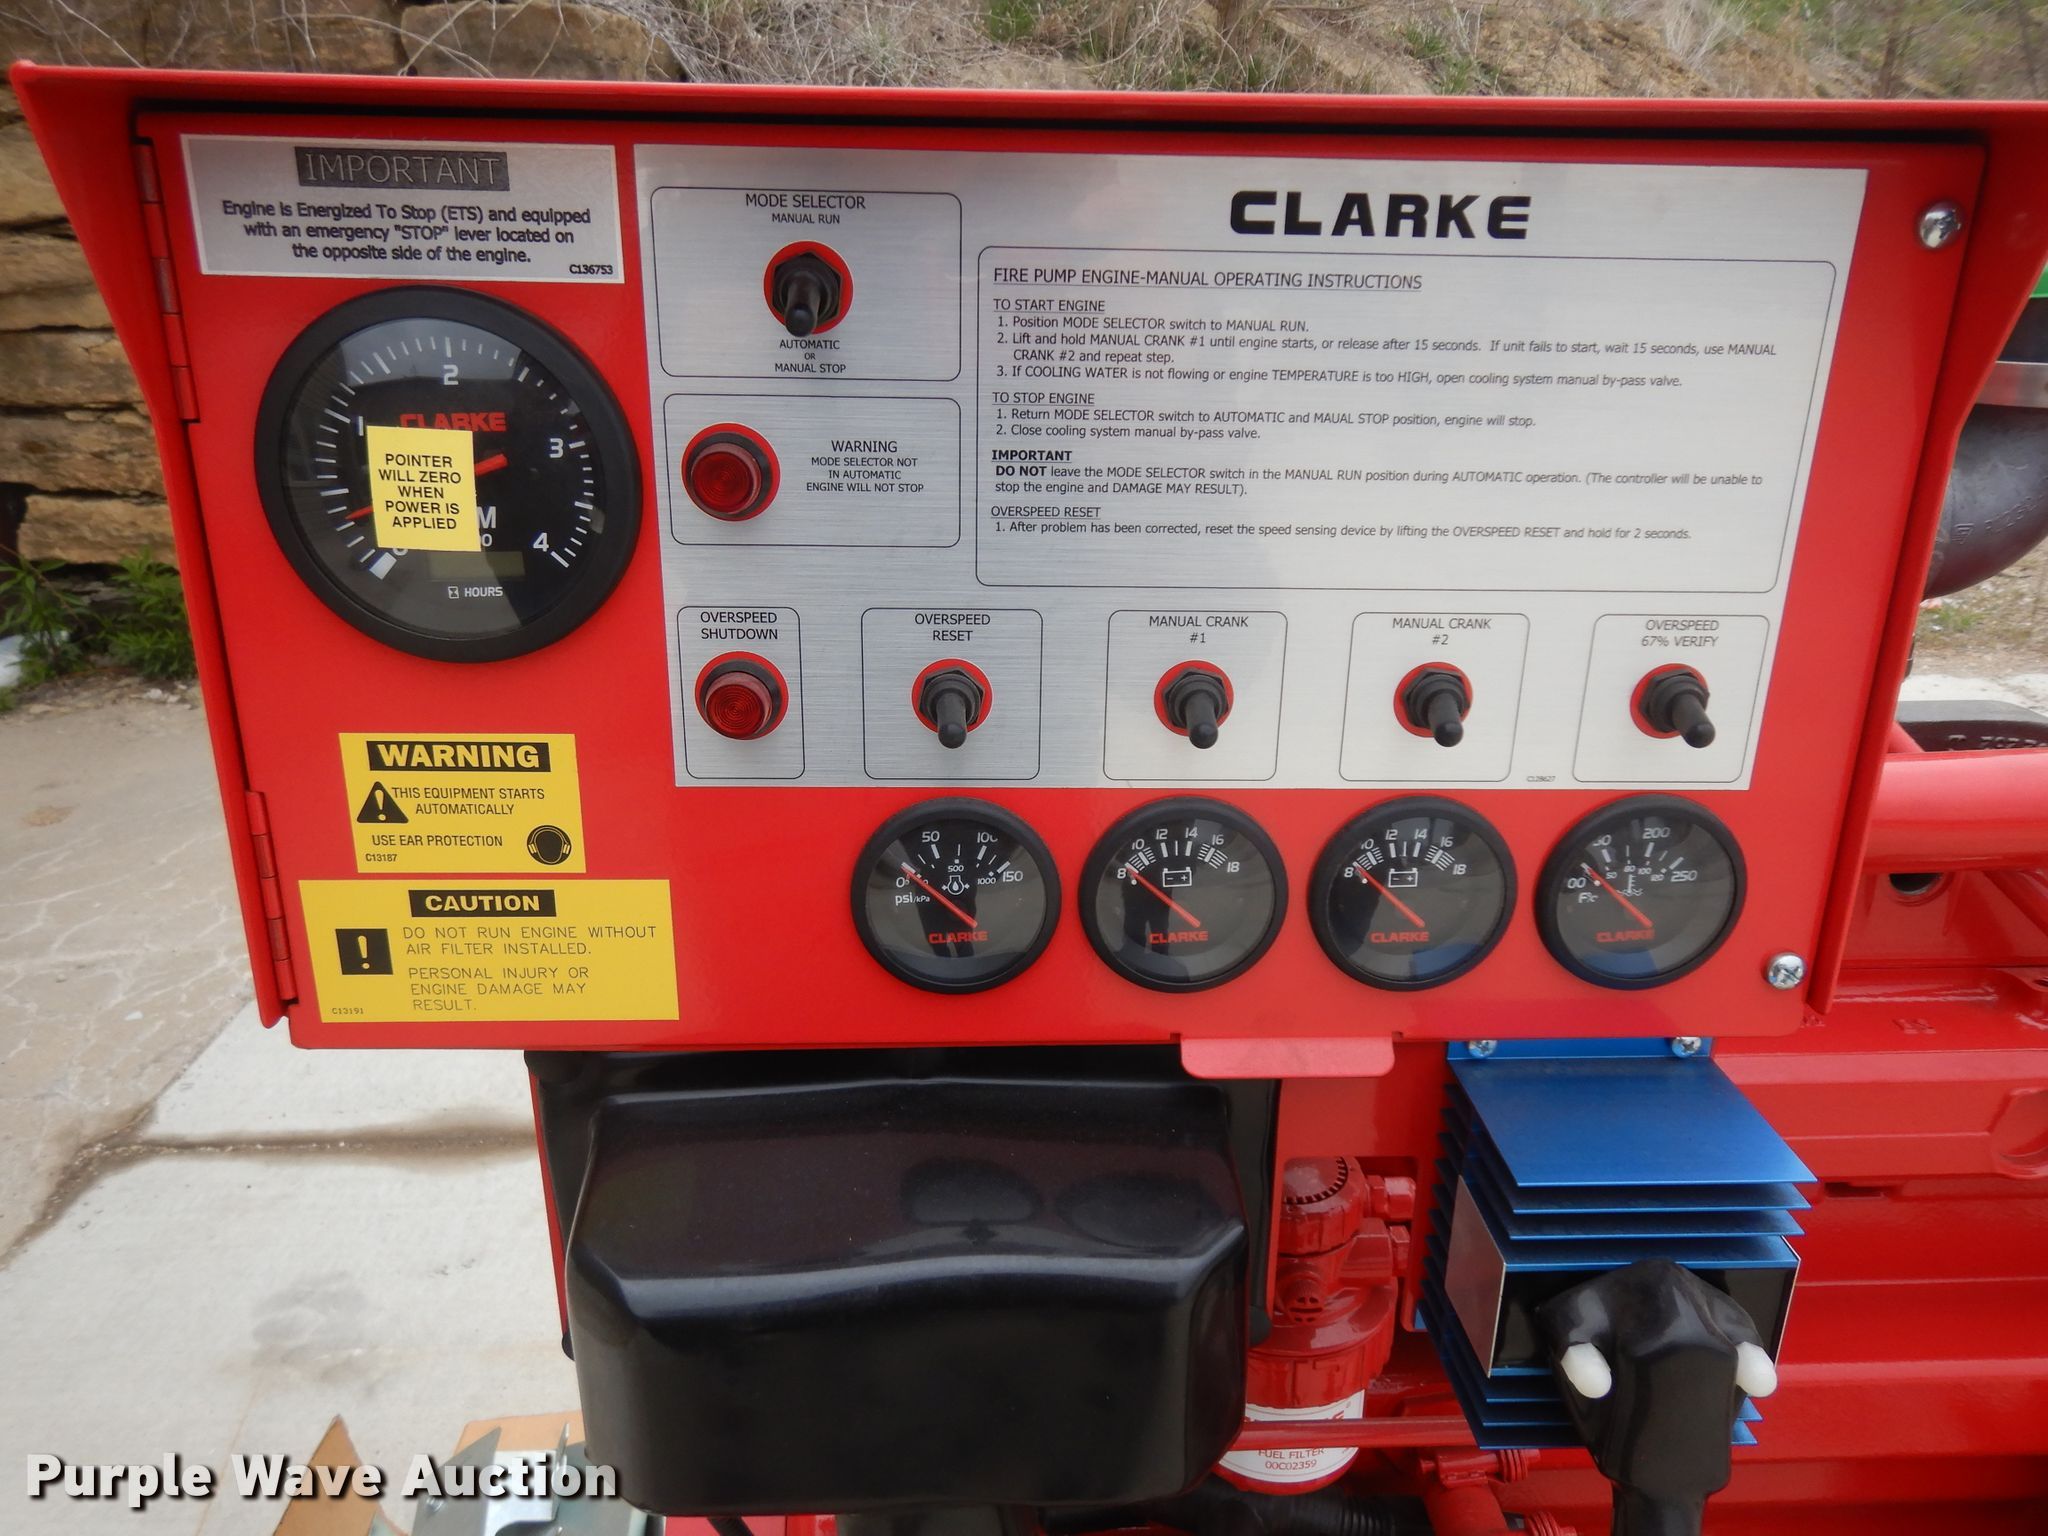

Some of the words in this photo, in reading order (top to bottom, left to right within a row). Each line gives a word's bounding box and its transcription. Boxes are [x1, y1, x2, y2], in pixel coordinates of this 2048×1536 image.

[306, 152, 499, 185] IMPORTANT
[745, 193, 787, 207] MODE
[792, 194, 865, 209] SELECTOR
[222, 200, 275, 218] Engine
[279, 201, 292, 216] is
[296, 202, 371, 221] Energized
[375, 203, 397, 219] To
[400, 204, 436, 223] Stop
[440, 204, 483, 224] (ETS)
[488, 206, 516, 221] and
[521, 207, 590, 226] equipped
[771, 212, 814, 224] MANUAL
[818, 213, 840, 224] RUN
[1231, 190, 1531, 240] CLARKE
[243, 221, 277, 236] with
[281, 225, 301, 237] an
[305, 225, 389, 242] emergency
[393, 222, 448, 240] "STOP"
[454, 223, 491, 241] lever
[495, 224, 550, 243] located
[554, 224, 574, 243] on
[291, 242, 318, 257] the
[322, 244, 387, 261] opposite
[391, 245, 422, 260] side
[426, 245, 442, 260] of
[445, 246, 471, 261] the
[475, 247, 530, 265] engine.
[569, 264, 613, 276] C136753
[994, 267, 1028, 282] FIRE
[1034, 268, 1076, 283] PUMP
[1082, 269, 1208, 286] ENGINE-MANUAL
[1214, 271, 1302, 287] OPERATING
[1307, 273, 1422, 289] INSTRUCTIONS
[993, 298, 1010, 311] TO
[1014, 298, 1054, 310] START
[1058, 299, 1104, 312] ENGINE
[998, 315, 1008, 327] 1.
[1013, 315, 1058, 328] Position
[1063, 316, 1098, 328] MODE
[1103, 317, 1165, 329] SELECTOR
[1169, 318, 1206, 330] switch
[1210, 319, 1222, 330] to
[1226, 319, 1275, 331] MANUAL
[1279, 320, 1308, 332] RUN.
[779, 339, 839, 349] AUTOMATIC
[804, 352, 815, 360] OR
[1013, 348, 1054, 360] CRANK
[1059, 349, 1075, 361] #2
[1079, 350, 1100, 361] and
[1105, 351, 1142, 364] repeat
[1146, 351, 1174, 365] step.
[774, 362, 816, 372] MANUAL
[819, 363, 846, 373] STOP
[443, 364, 460, 386] 2
[992, 391, 1010, 404] TO
[1011, 391, 1045, 404] STOP
[1049, 391, 1094, 404] ENGINE
[549, 438, 564, 458] 3
[831, 440, 897, 452] WARNING
[385, 453, 452, 467] POINTER
[811, 456, 840, 466] MODE
[843, 457, 893, 466] SELECTOR
[896, 457, 917, 467] NOT
[992, 449, 1072, 463] IMPORTANT
[378, 468, 415, 482] WILL
[419, 470, 461, 484] ZERO
[828, 469, 839, 478] IN
[842, 469, 901, 479] AUTOMATIC
[397, 485, 443, 498] WHEN
[806, 482, 843, 491] ENGINE
[846, 482, 871, 491] WILL
[874, 482, 895, 492] NOT
[898, 483, 923, 492] STOP
[385, 500, 440, 514] POWER
[445, 502, 459, 514] IS
[990, 505, 1060, 519] OVERSPEED
[1064, 506, 1101, 519] RESET
[392, 516, 456, 529] APPLIED
[533, 532, 549, 552] 4
[464, 586, 503, 597] HOURS
[700, 611, 777, 623] OVERSPEED
[914, 613, 990, 625] OVERSPEED
[1149, 615, 1202, 627] MANUAL
[1205, 615, 1248, 627] CRANK
[1392, 617, 1444, 629] MANUAL
[1448, 617, 1491, 629] CRANK
[1645, 619, 1719, 631] OVERSPEED
[701, 627, 777, 639] SHUTDOWN
[932, 629, 973, 641] RESET
[1189, 632, 1205, 643] #1
[1432, 634, 1448, 645] #2
[1641, 635, 1669, 647] 67%
[1674, 635, 1718, 647] VERIFY
[377, 744, 539, 768] WARNING
[391, 787, 420, 799] THIS
[423, 787, 495, 798] EQUIPMENT
[498, 787, 544, 799] STARTS
[415, 803, 514, 814] AUTOMATICALLY
[921, 831, 940, 843] 50
[1155, 828, 1169, 840] 12
[1185, 826, 1198, 839] 14
[1385, 829, 1399, 841] 12
[1414, 828, 1428, 840] 14
[1642, 826, 1671, 840] 200
[371, 834, 396, 846] USE
[399, 834, 423, 846] EAR
[426, 834, 502, 846] PROTECTION
[1131, 838, 1145, 851] 10
[1212, 834, 1225, 846] 16
[1361, 838, 1375, 850] 10
[1440, 836, 1453, 848] 16
[365, 853, 397, 862] C13187
[947, 864, 965, 874] 500
[1227, 861, 1240, 873] 18
[1343, 866, 1354, 878] 8
[1452, 863, 1467, 875] 18
[1002, 870, 1024, 882] 150
[1116, 867, 1127, 880] 8
[1670, 870, 1698, 882] 250
[977, 877, 997, 885] 1000
[425, 895, 539, 911] CAUTION
[402, 926, 425, 939] DO
[435, 926, 466, 939] NOT
[477, 926, 510, 938] RUN
[520, 926, 577, 938] ENGINE
[587, 925, 656, 938] WITHOUT
[928, 930, 989, 944] CLARKE
[1149, 930, 1209, 945] CLARKE
[1370, 931, 1430, 944] CLARKE
[406, 942, 431, 954] AIR
[441, 942, 493, 955] FILTER
[503, 942, 591, 954] INSTALLED.
[408, 967, 492, 979] PERSONAL
[502, 966, 558, 979] INJURY
[568, 966, 589, 978] OR
[410, 983, 467, 995] ENGINE
[477, 982, 543, 995] DAMAGE
[552, 982, 585, 994] MAY
[412, 998, 476, 1011] RESULT.
